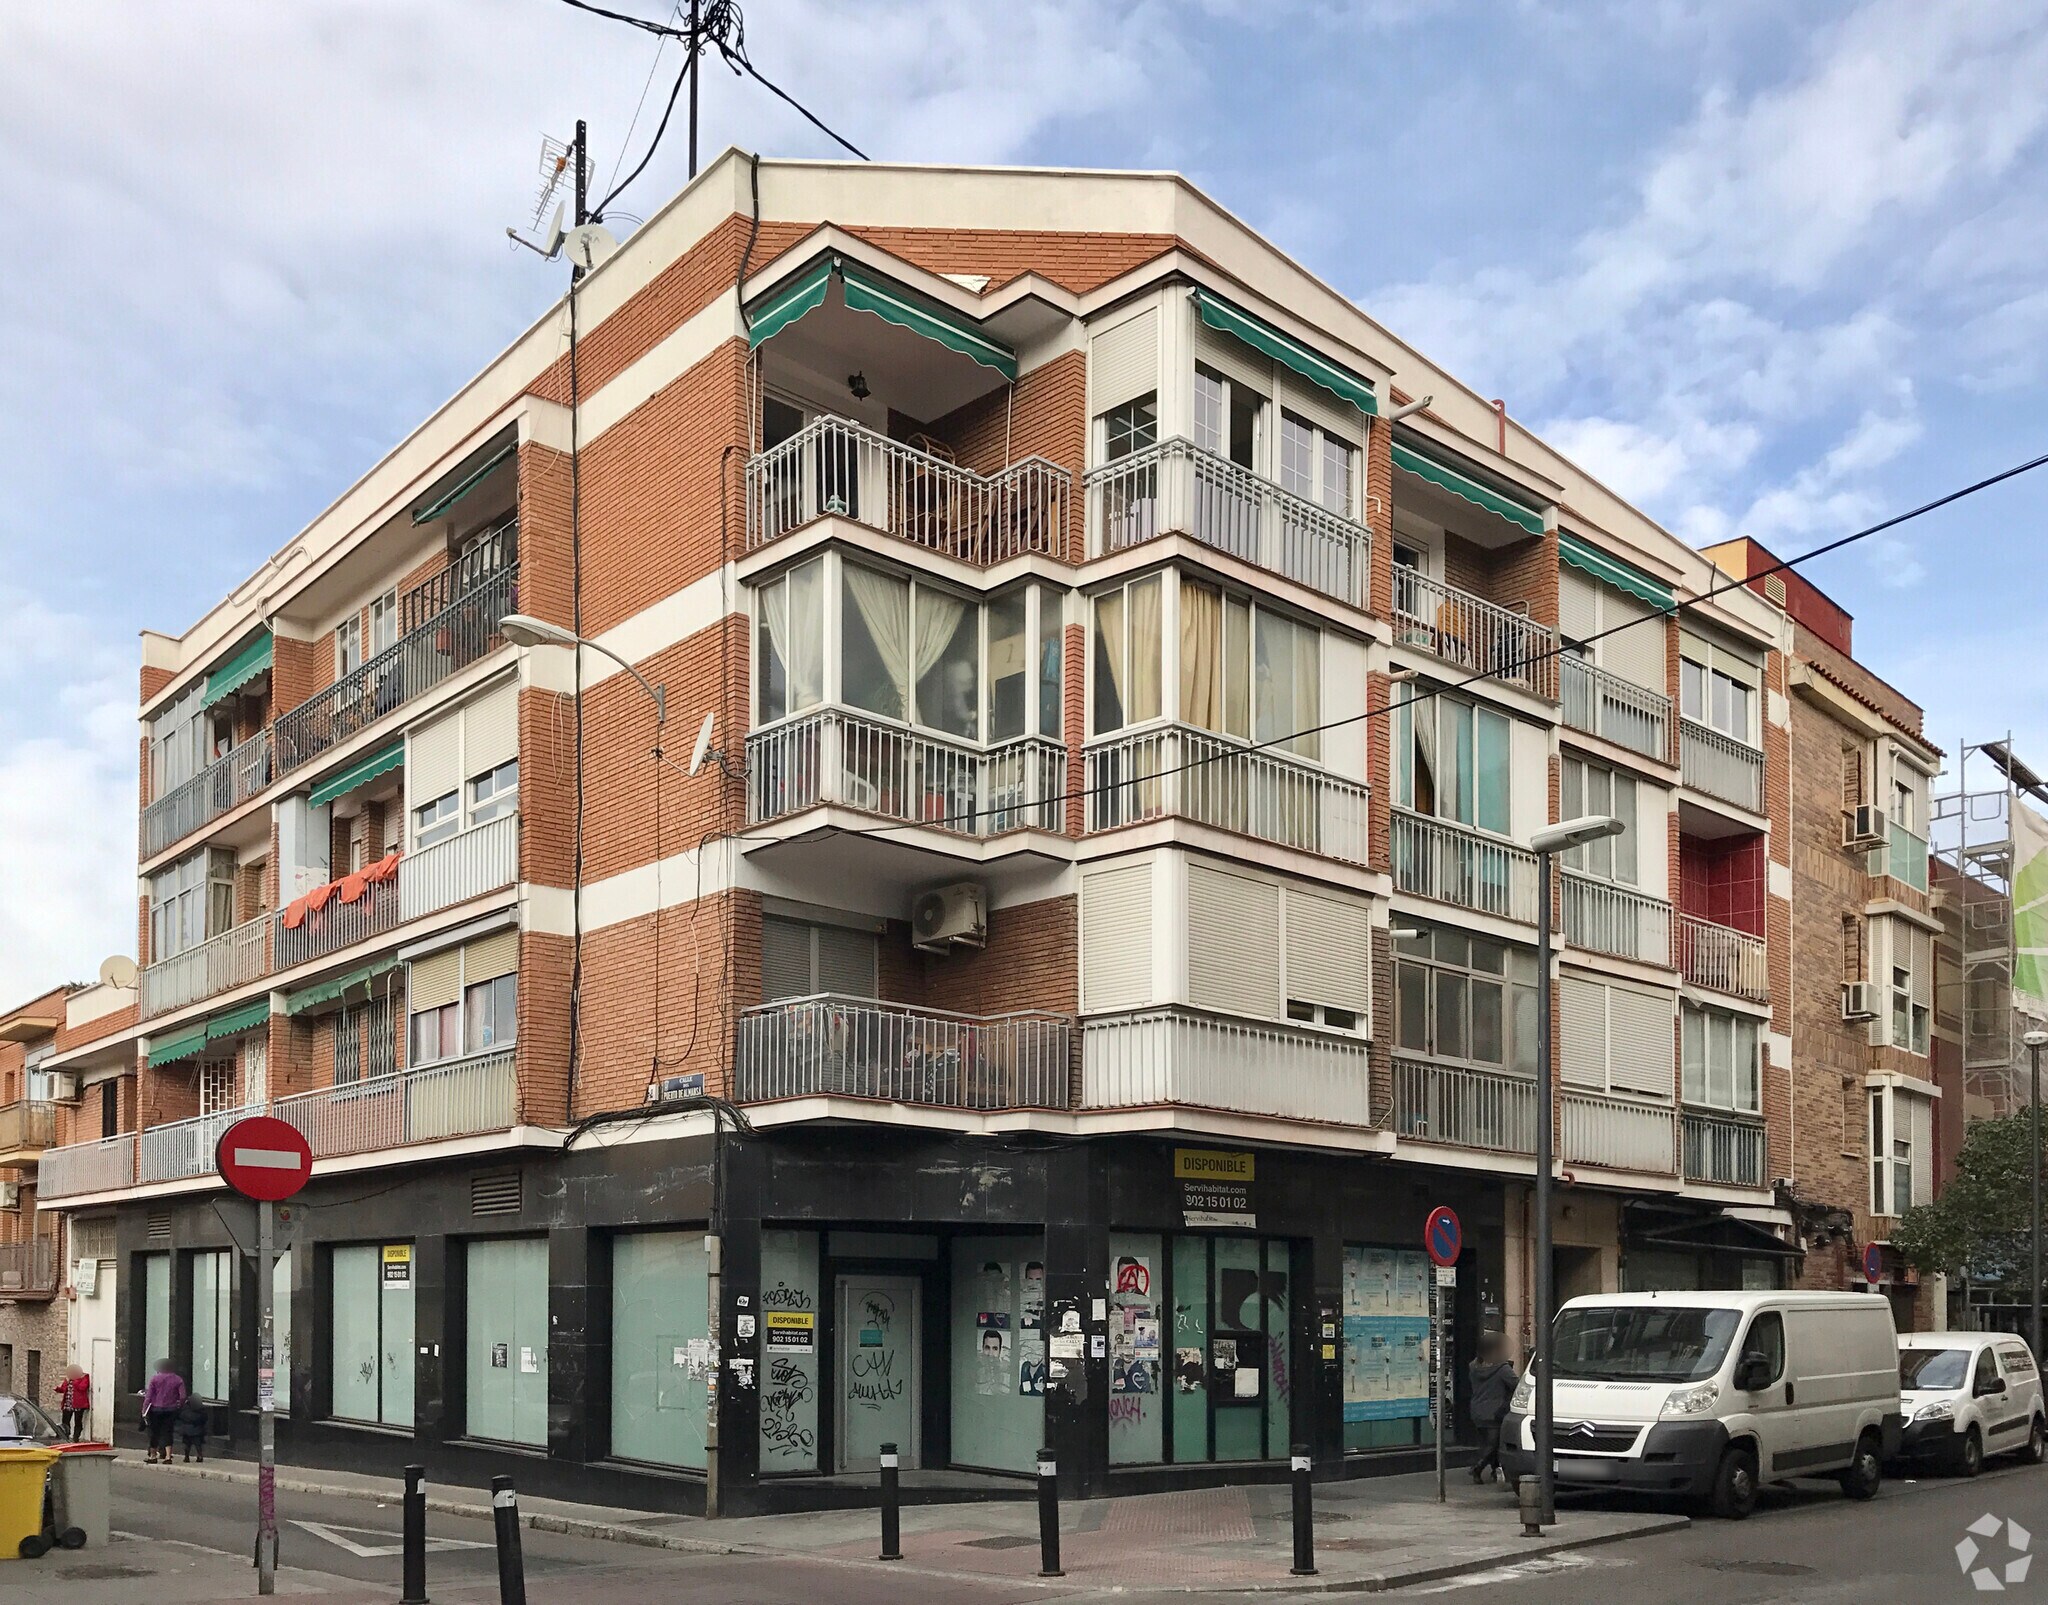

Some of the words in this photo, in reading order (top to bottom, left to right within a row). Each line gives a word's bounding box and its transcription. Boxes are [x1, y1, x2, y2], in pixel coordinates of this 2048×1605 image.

[664, 1090, 678, 1100] PUERTO
[678, 1089, 683, 1099] DE
[684, 1086, 702, 1097] ALMANSA
[1184, 1157, 1246, 1173] DISPONIBLE
[1184, 1183, 1247, 1194] Servihabitat.com
[1185, 1195, 1204, 1207] 902
[1206, 1196, 1218, 1207] 15
[1219, 1197, 1231, 1208] 01
[1233, 1198, 1246, 1208] 02
